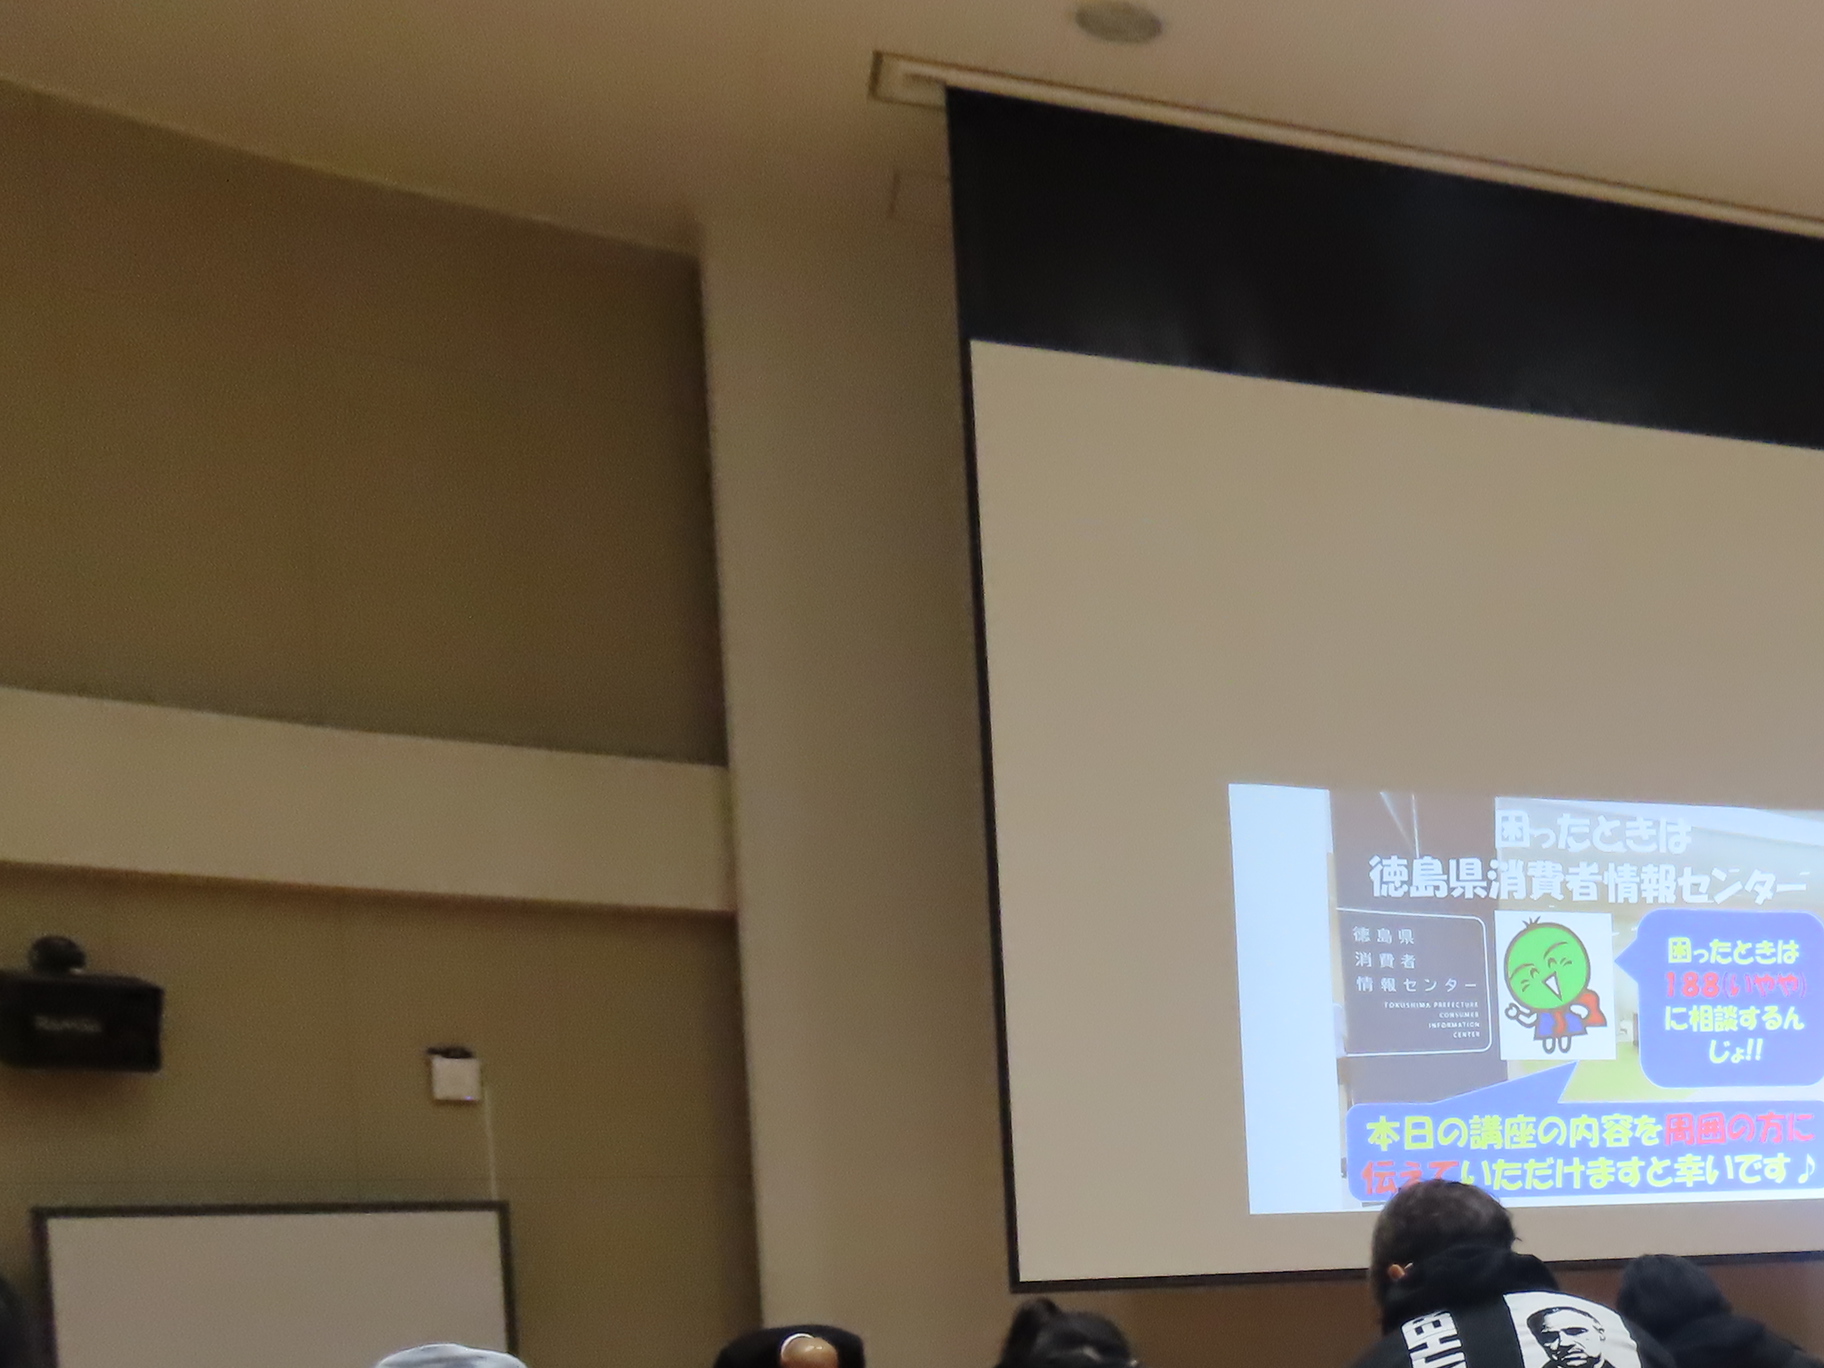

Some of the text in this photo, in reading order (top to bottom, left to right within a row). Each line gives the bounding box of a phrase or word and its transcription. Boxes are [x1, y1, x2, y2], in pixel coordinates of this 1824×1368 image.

[1494, 809, 1693, 854] 困ったときは
[1368, 854, 1808, 905] 徳島県消費者情報センター
[1352, 925, 1415, 945] 徳島県
[1354, 951, 1416, 969] 消費者
[1667, 937, 1800, 965] 困ったときは
[1355, 975, 1477, 993] 情報センター
[1666, 971, 1807, 998] 188(いやや)
[1384, 1001, 1431, 1009] TOKUSHIMA
[1428, 1021, 1480, 1029] INFORMATION
[1664, 1004, 1805, 1032] に相談するん
[1452, 1031, 1481, 1039] CENTER
[1366, 1111, 1815, 1152] 本日の講座の内容を周囲の方に
